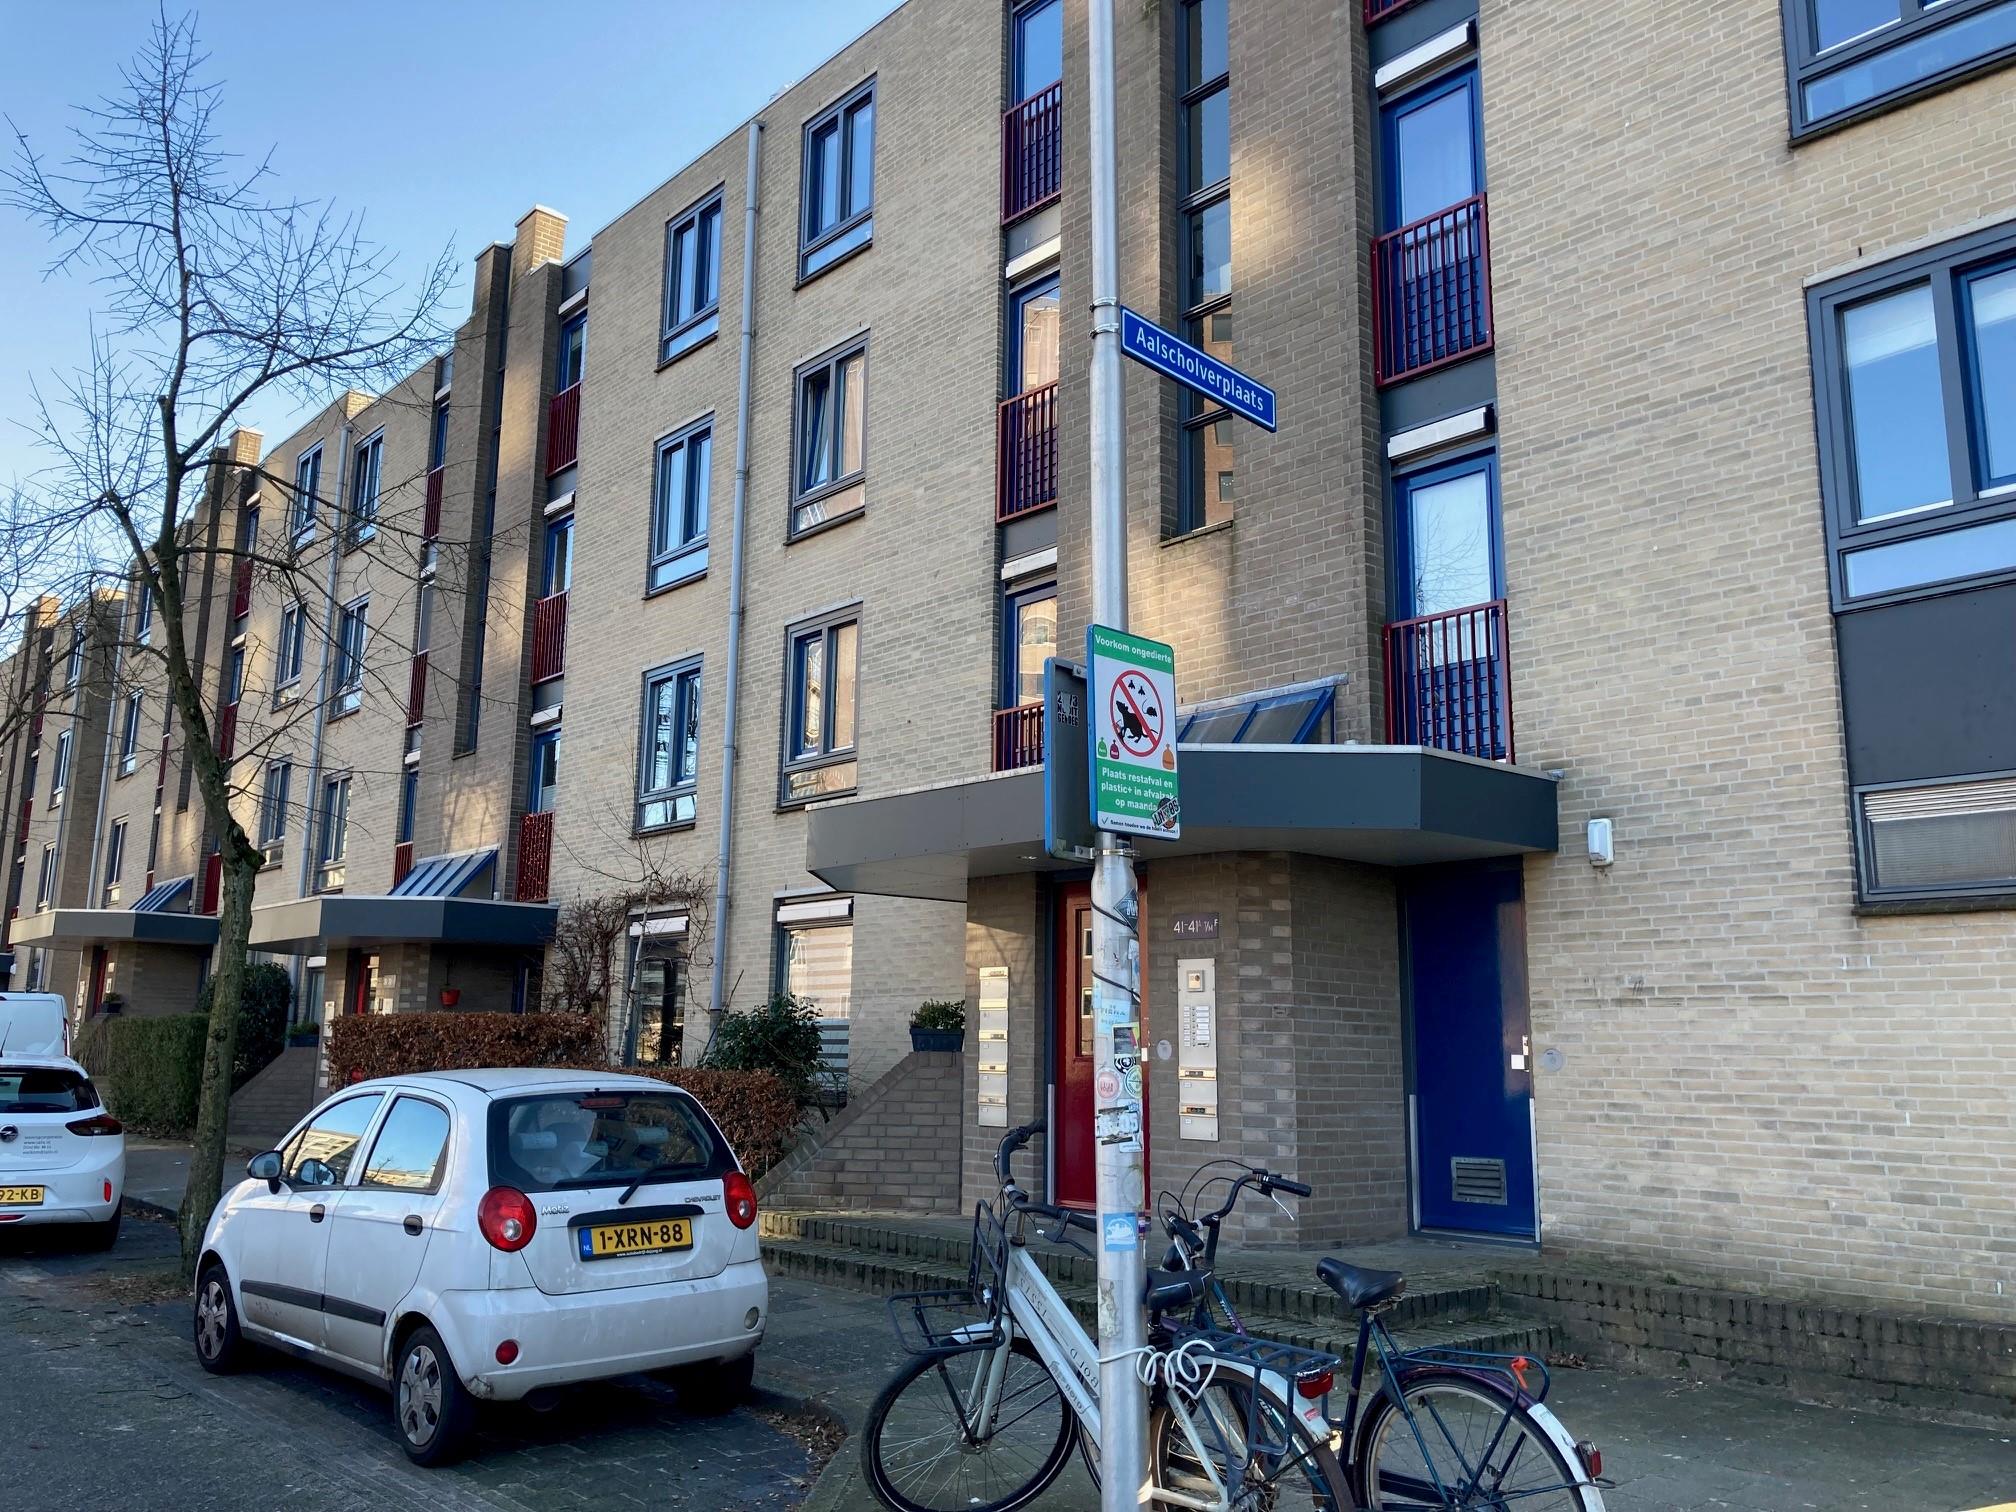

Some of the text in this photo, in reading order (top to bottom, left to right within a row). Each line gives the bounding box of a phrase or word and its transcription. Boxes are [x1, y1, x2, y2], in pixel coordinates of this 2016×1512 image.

[1136, 326, 1264, 411] Aalscholverplaats
[1095, 634, 1172, 663] Voorkom ongedierte
[1102, 767, 1173, 788] Plaats restafval en
[1101, 781, 1132, 794] plastic+
[1134, 786, 1142, 796] in
[1115, 798, 1158, 812] op maanda
[0, 1188, 39, 1201] 92-KB
[685, 1194, 721, 1203] CHEVROLET
[541, 1204, 570, 1216] Matiz
[599, 1223, 684, 1250] 1-XRN-88
[583, 1244, 592, 1252] NL
